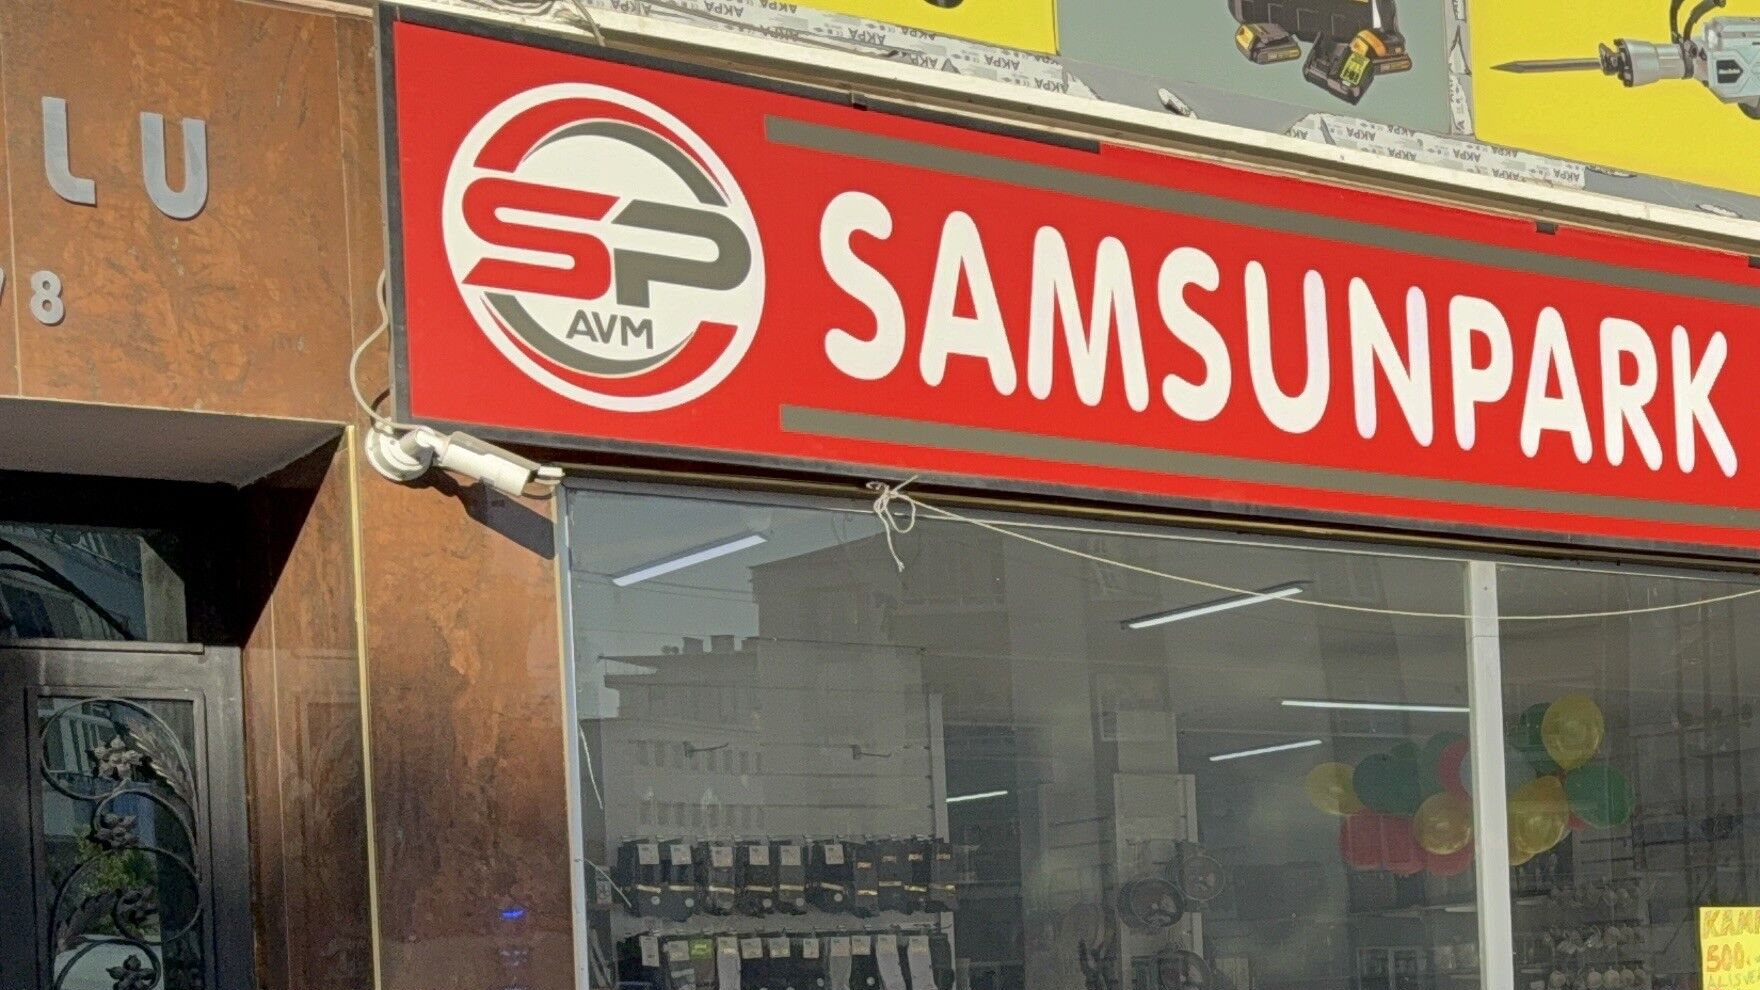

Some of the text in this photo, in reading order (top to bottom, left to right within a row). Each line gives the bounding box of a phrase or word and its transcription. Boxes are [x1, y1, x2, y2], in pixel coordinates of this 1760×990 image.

[462, 177, 752, 308] SP
[565, 309, 654, 350] AVM
[820, 191, 1738, 477] SAMSUNPARK
